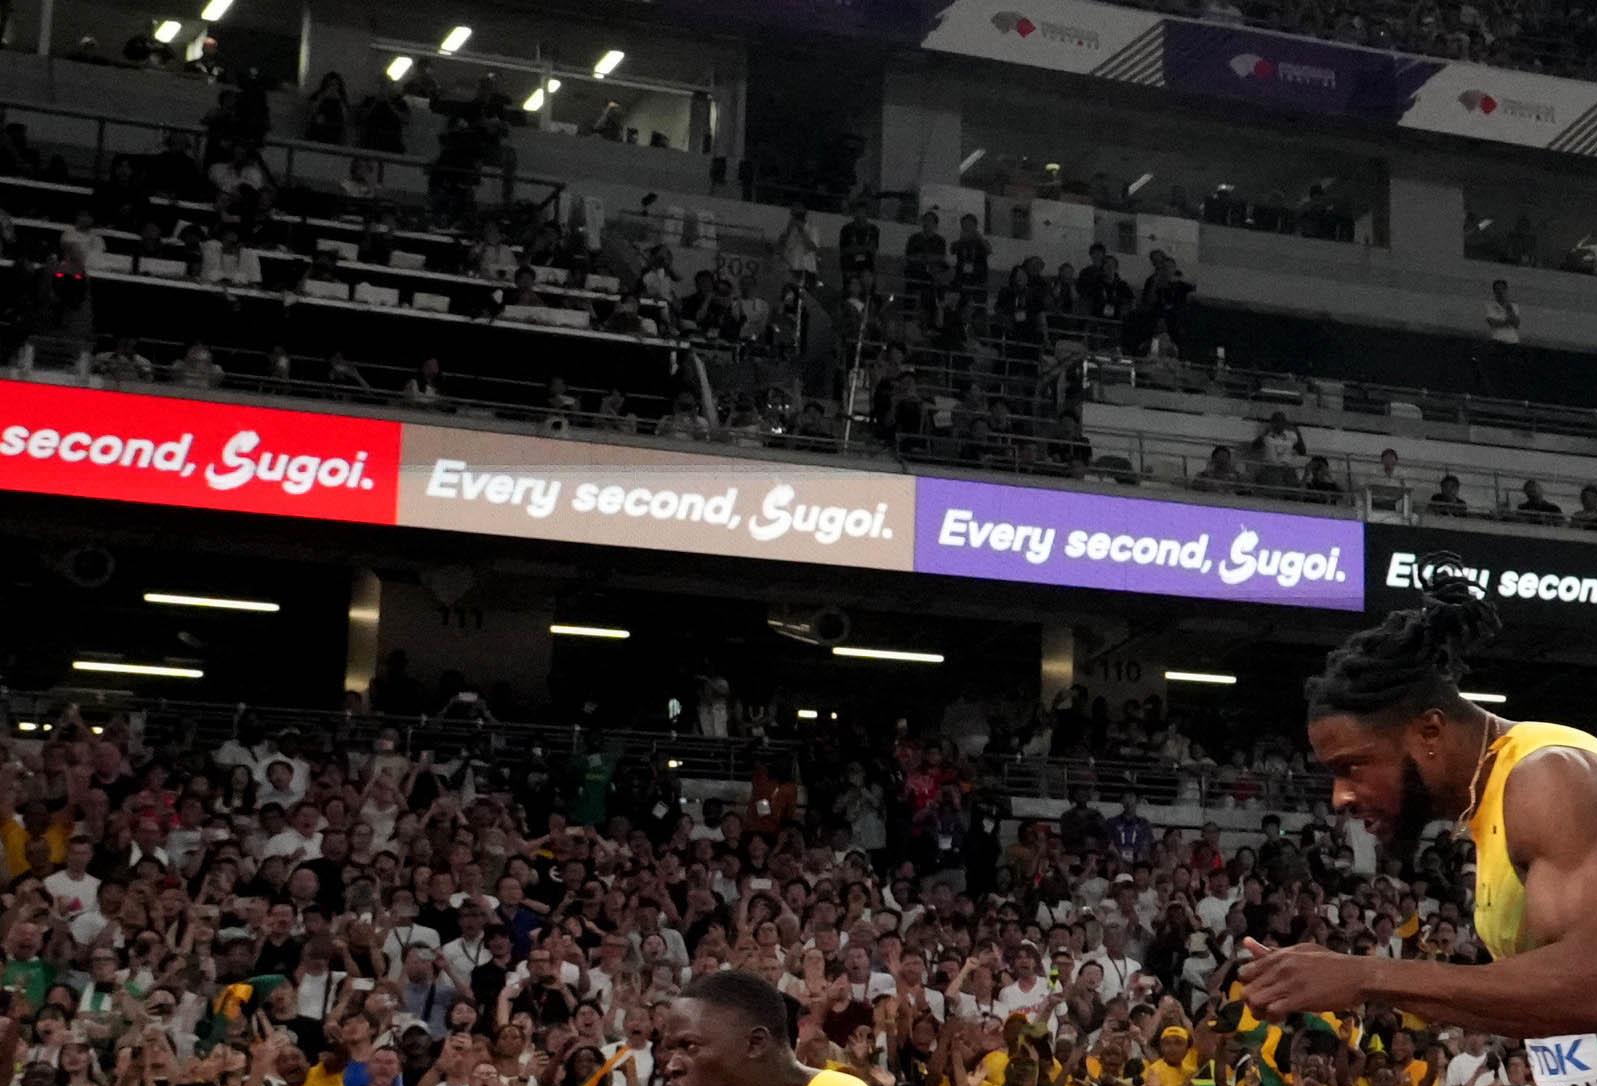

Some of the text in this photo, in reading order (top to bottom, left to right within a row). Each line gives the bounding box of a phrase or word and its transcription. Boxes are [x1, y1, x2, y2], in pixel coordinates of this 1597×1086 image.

[0, 425, 374, 495] second, Sugoi.
[426, 458, 893, 545] Every second, Sugoi.
[938, 508, 1346, 588] Every second, Sugoi.
[1530, 1038, 1592, 1076] TDK
